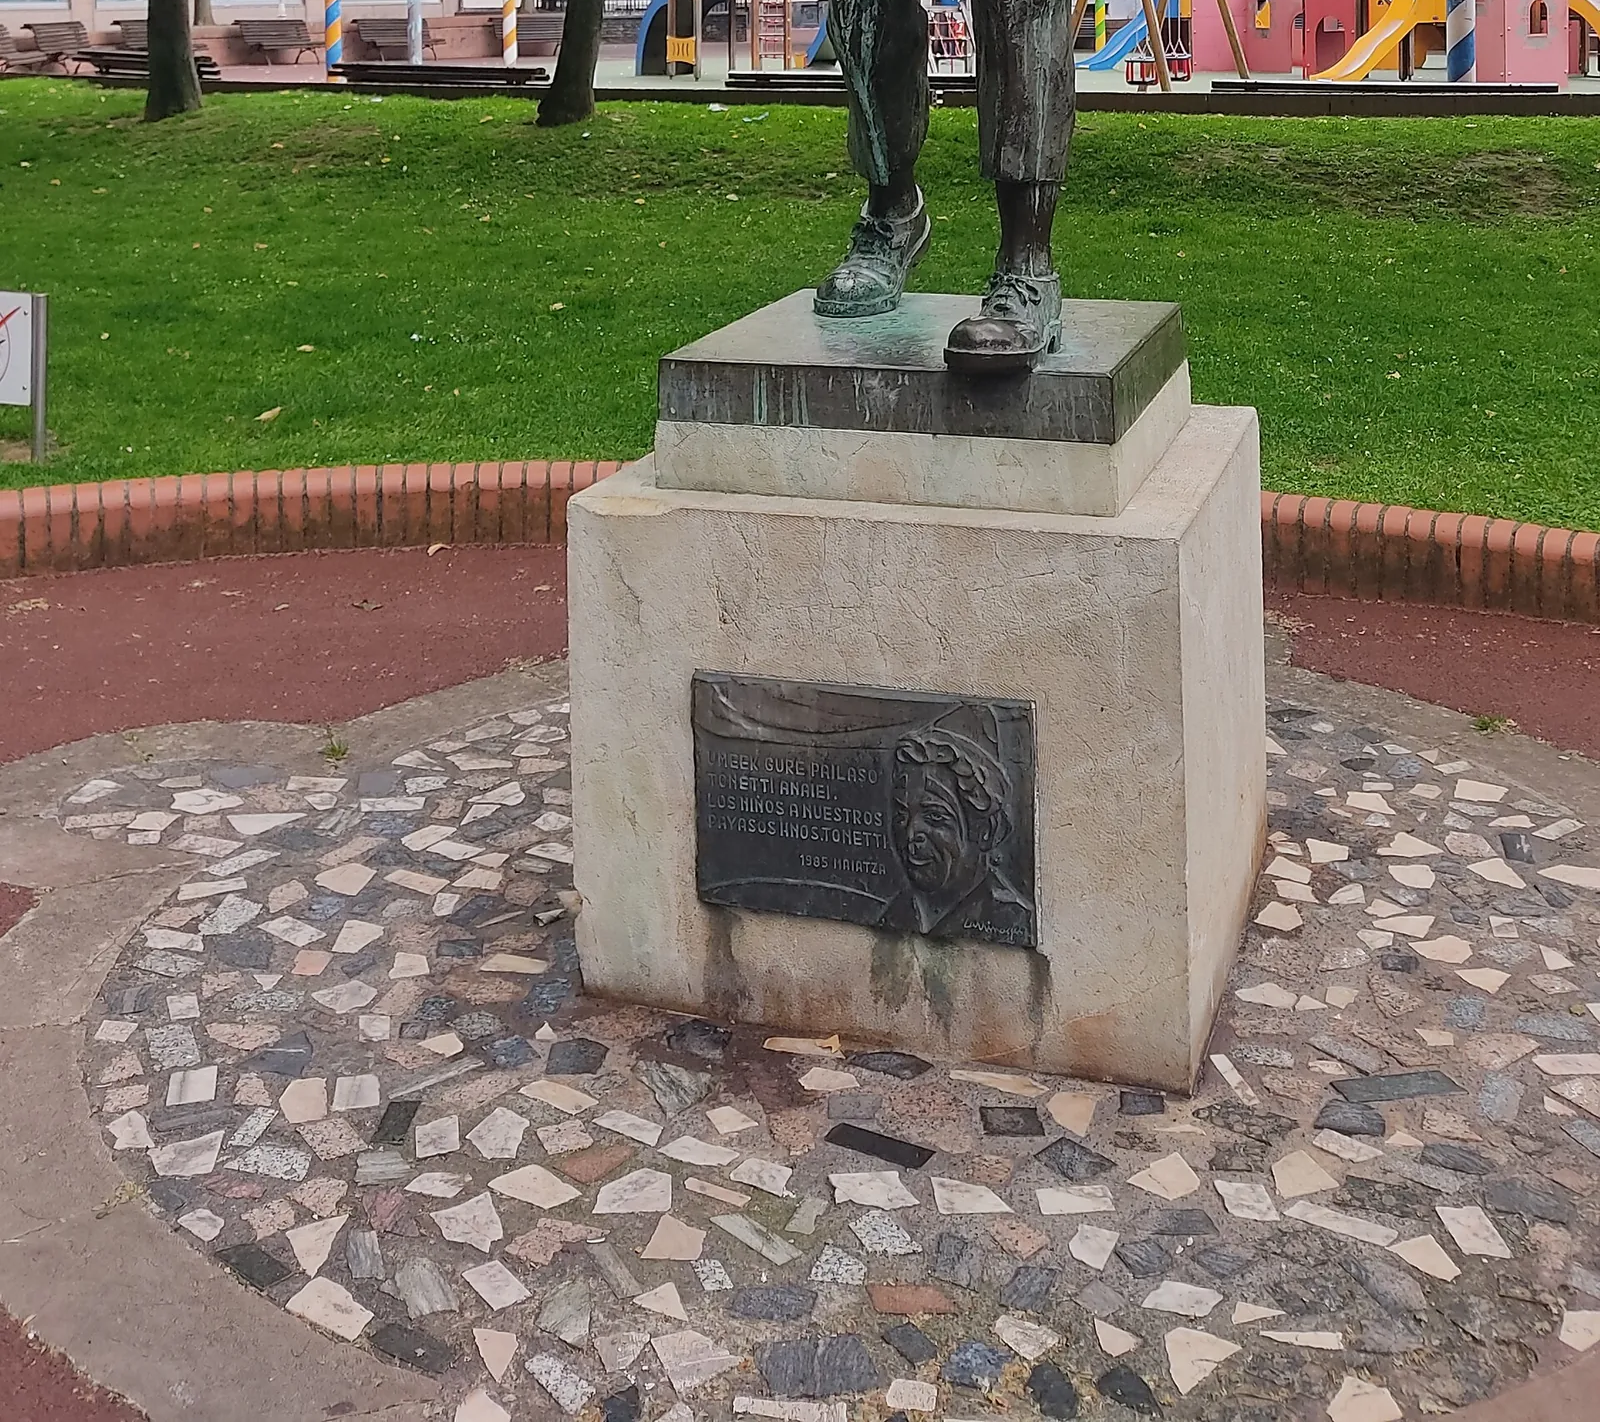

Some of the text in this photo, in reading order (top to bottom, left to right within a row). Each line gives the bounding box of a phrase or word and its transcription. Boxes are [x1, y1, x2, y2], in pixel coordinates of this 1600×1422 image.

[707, 751, 878, 784] UMEEK GURE PAILASO
[707, 773, 775, 794] TONETTI
[707, 792, 736, 809] LOS
[789, 803, 800, 818] A
[802, 803, 883, 827] NUESTROS
[708, 814, 777, 835] PAYASOS
[799, 854, 887, 875] 1985 MAIATZA
